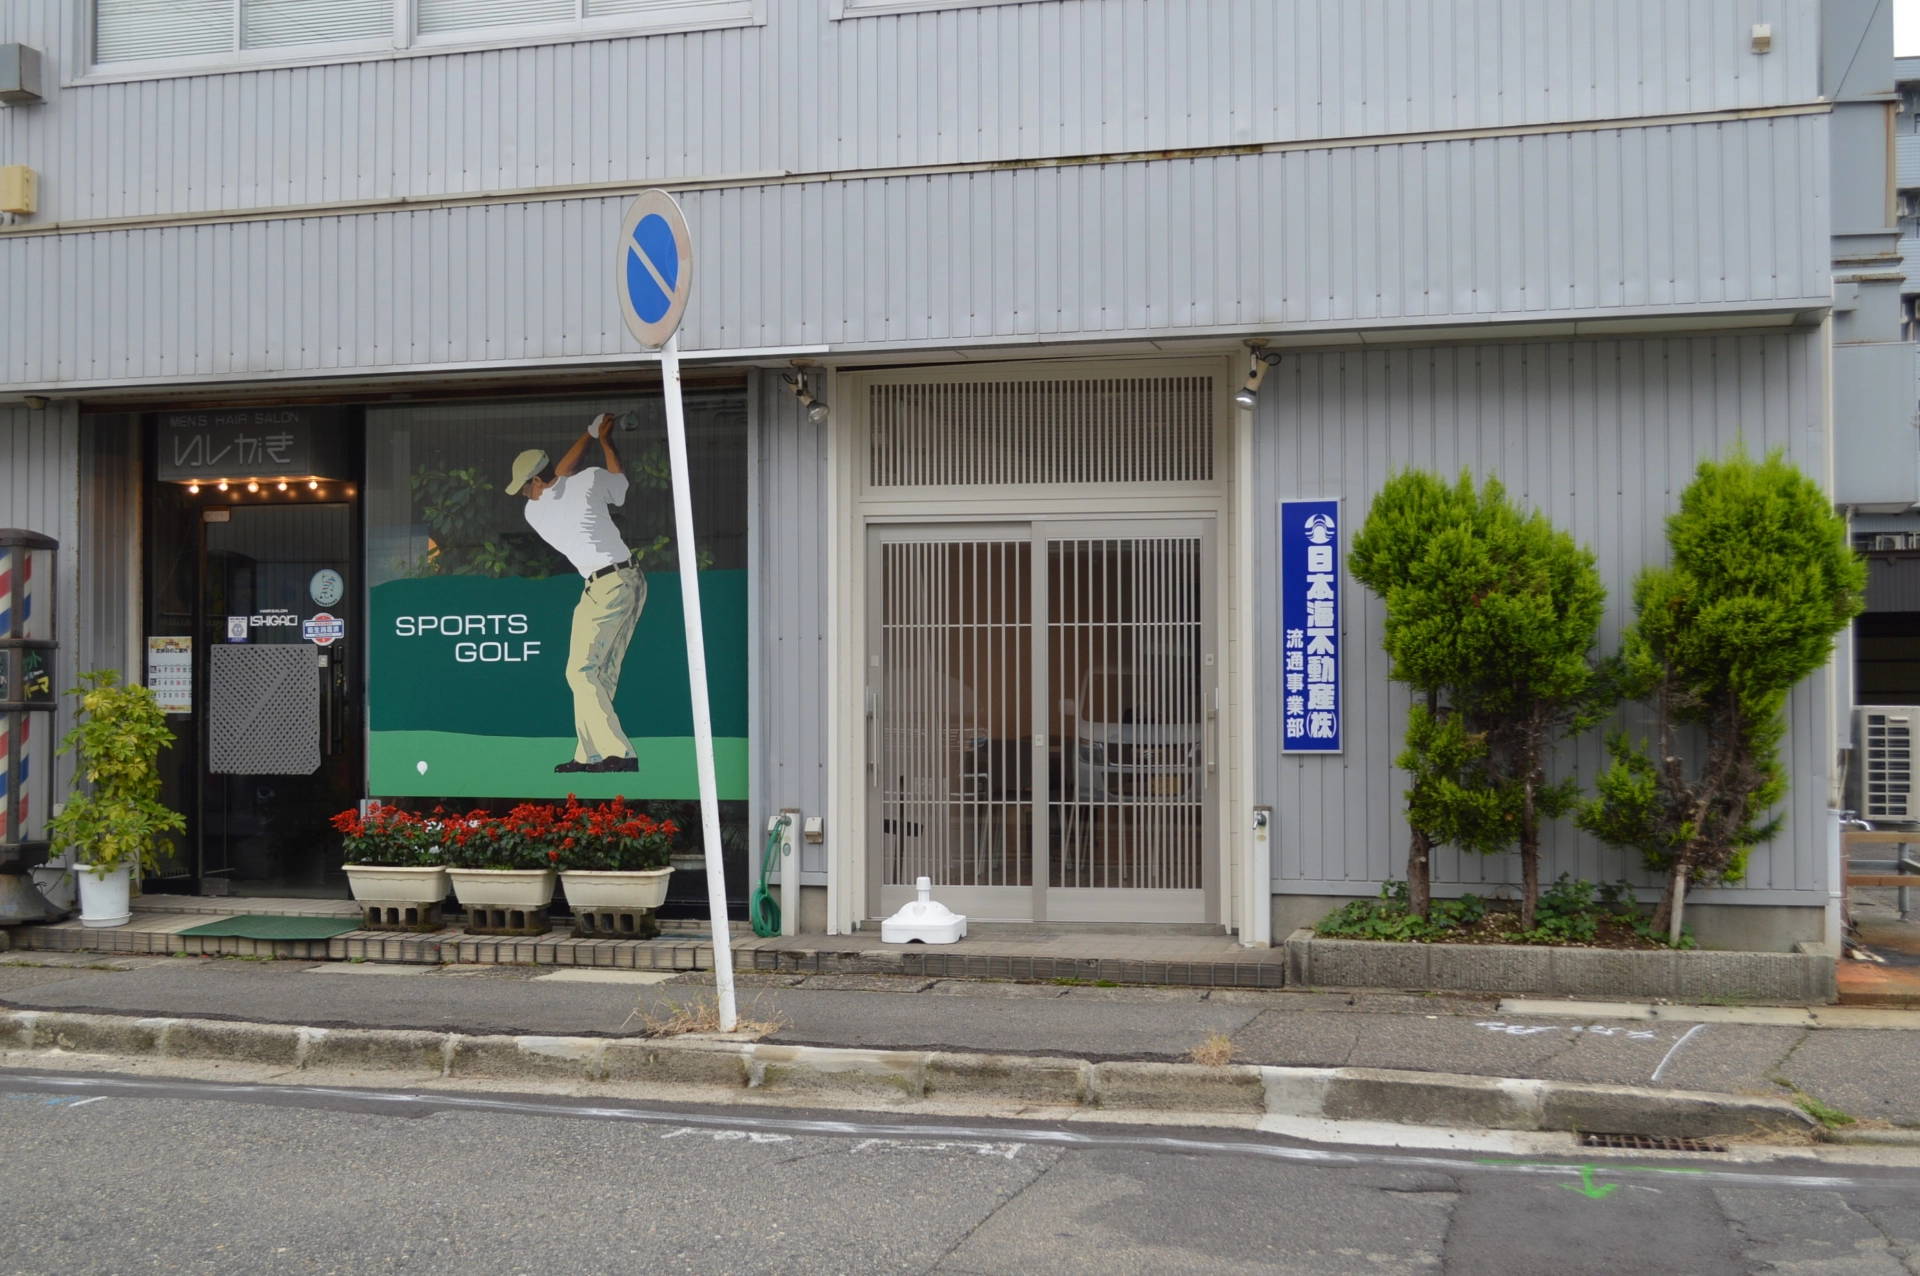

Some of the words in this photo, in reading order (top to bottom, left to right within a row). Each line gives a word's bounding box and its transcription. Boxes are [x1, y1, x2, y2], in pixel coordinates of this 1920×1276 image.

[215, 414, 248, 426] HAIR
[254, 411, 299, 425] SALON
[174, 431, 294, 467] いしがき
[395, 613, 528, 636] SPORTS
[455, 641, 541, 662] GOLF
[1286, 628, 1305, 738] 流通事業部
